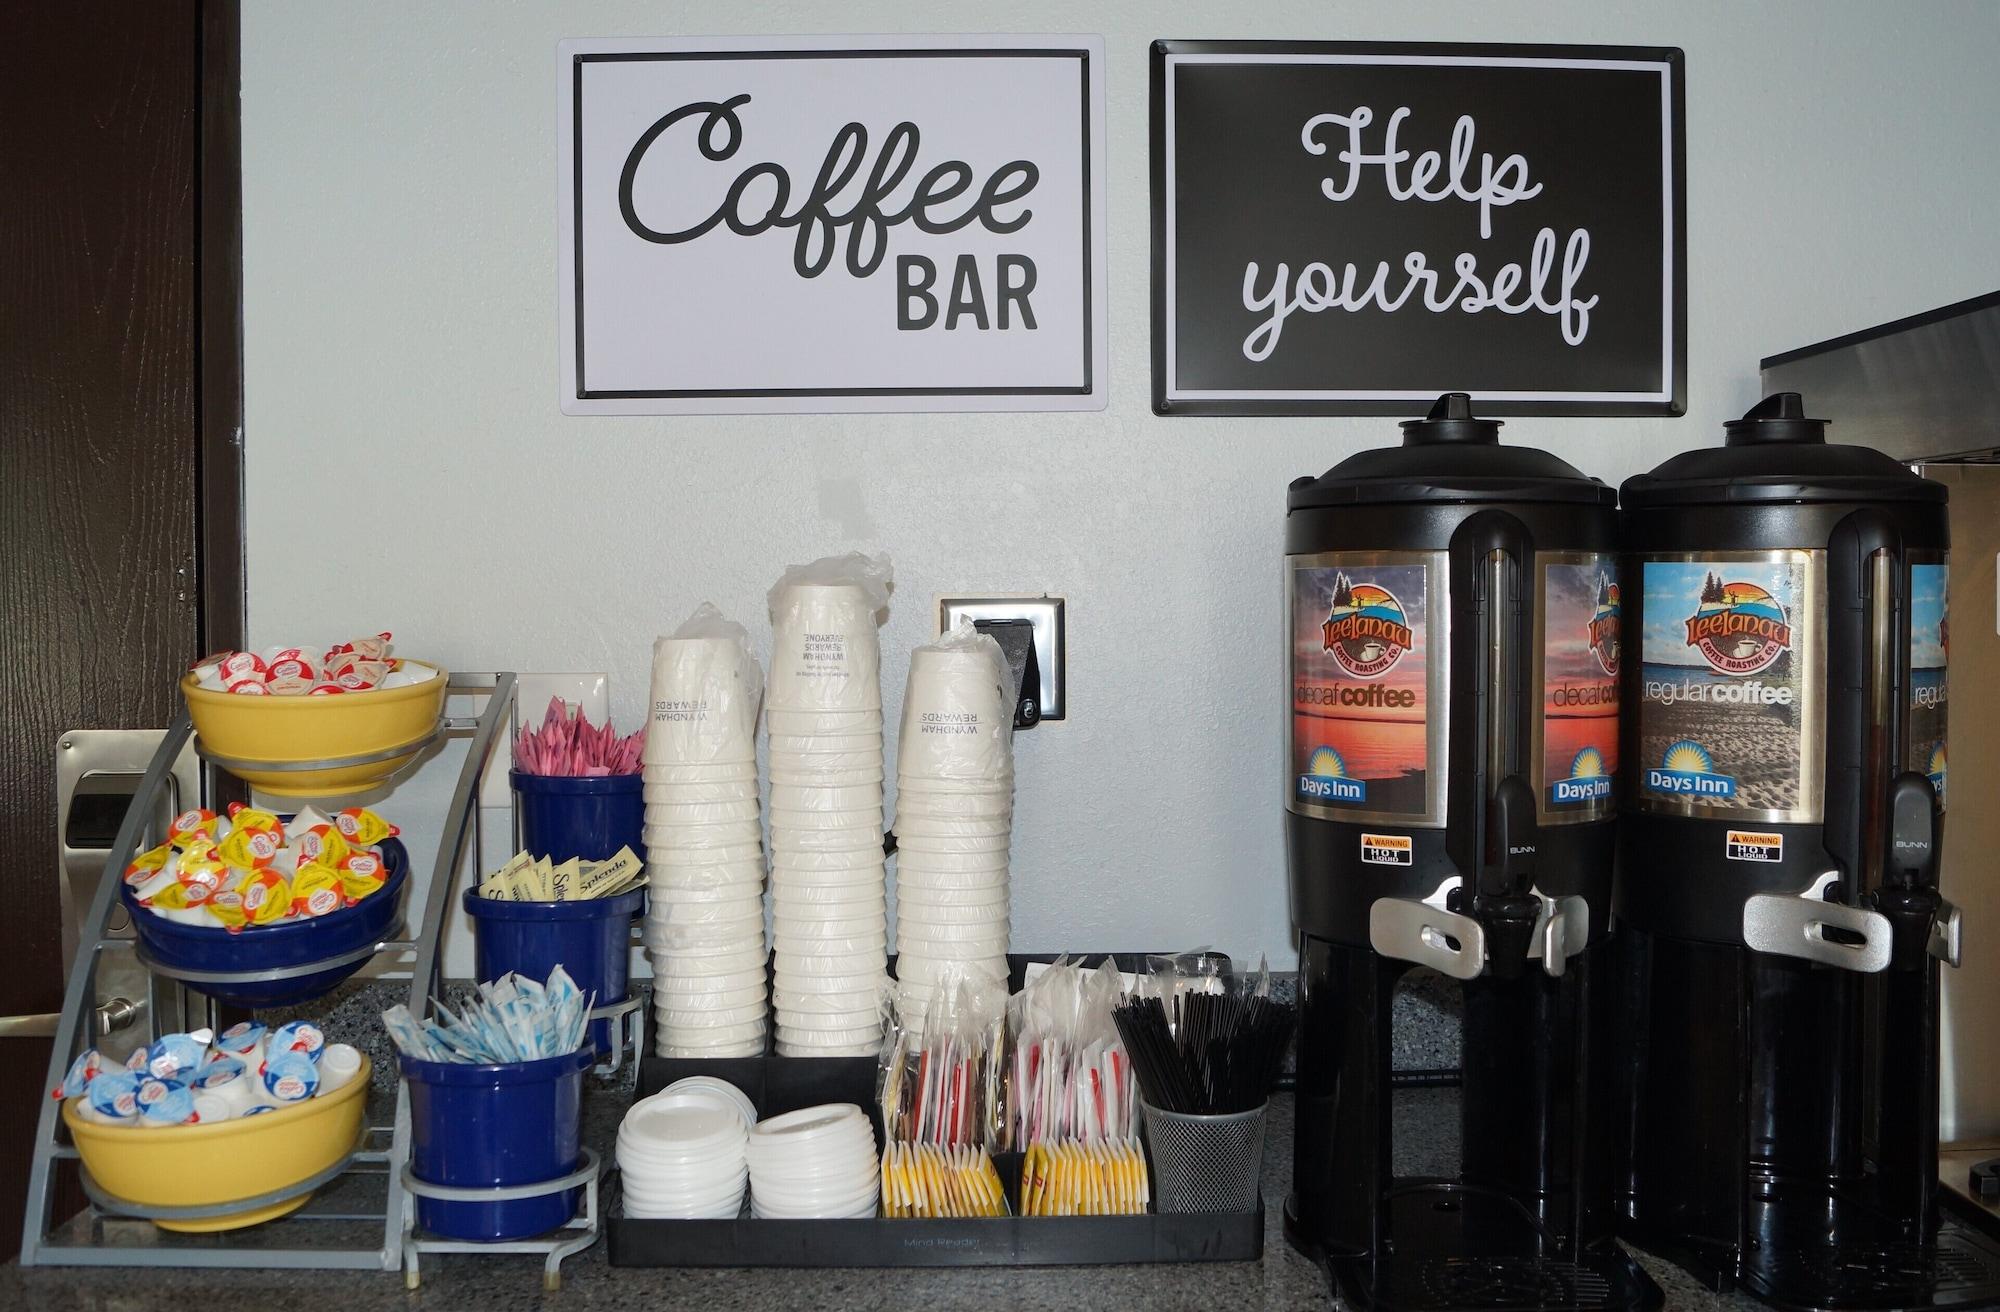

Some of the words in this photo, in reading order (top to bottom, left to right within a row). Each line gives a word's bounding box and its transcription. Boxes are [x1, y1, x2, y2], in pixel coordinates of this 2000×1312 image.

[1301, 106, 1543, 239] Help
[618, 93, 1040, 279] Coffee
[896, 254, 1038, 331] BAR
[1242, 227, 1599, 362] yourself
[802, 652, 844, 661] WYNDHAM
[804, 643, 842, 651] REWARDS
[1702, 642, 1722, 664] COFFEE
[1726, 655, 1765, 669] ROASTING
[1335, 645, 1352, 668] COFFEE
[1355, 658, 1389, 673] ROASTING
[1340, 684, 1416, 708] coffee
[1645, 678, 1712, 706] regular
[1711, 681, 1793, 705] coffee
[655, 701, 707, 710] REWARDS
[655, 712, 708, 721] WYNDHAM
[921, 712, 978, 722] REWARDS
[921, 724, 978, 734] WYNDHAM
[1301, 776, 1331, 796] Days
[1332, 780, 1360, 798] Inn
[1558, 783, 1593, 799] Days
[1594, 780, 1610, 795] Inn
[1650, 771, 1692, 791] Days
[1695, 776, 1729, 793] Inn
[1374, 838, 1408, 848] WARNING
[1741, 835, 1778, 845] WARNING
[1896, 841, 1928, 849] BUNN
[1371, 855, 1399, 863] LIQUID
[1510, 846, 1536, 854] BUNN
[579, 859, 626, 895] Splenda
